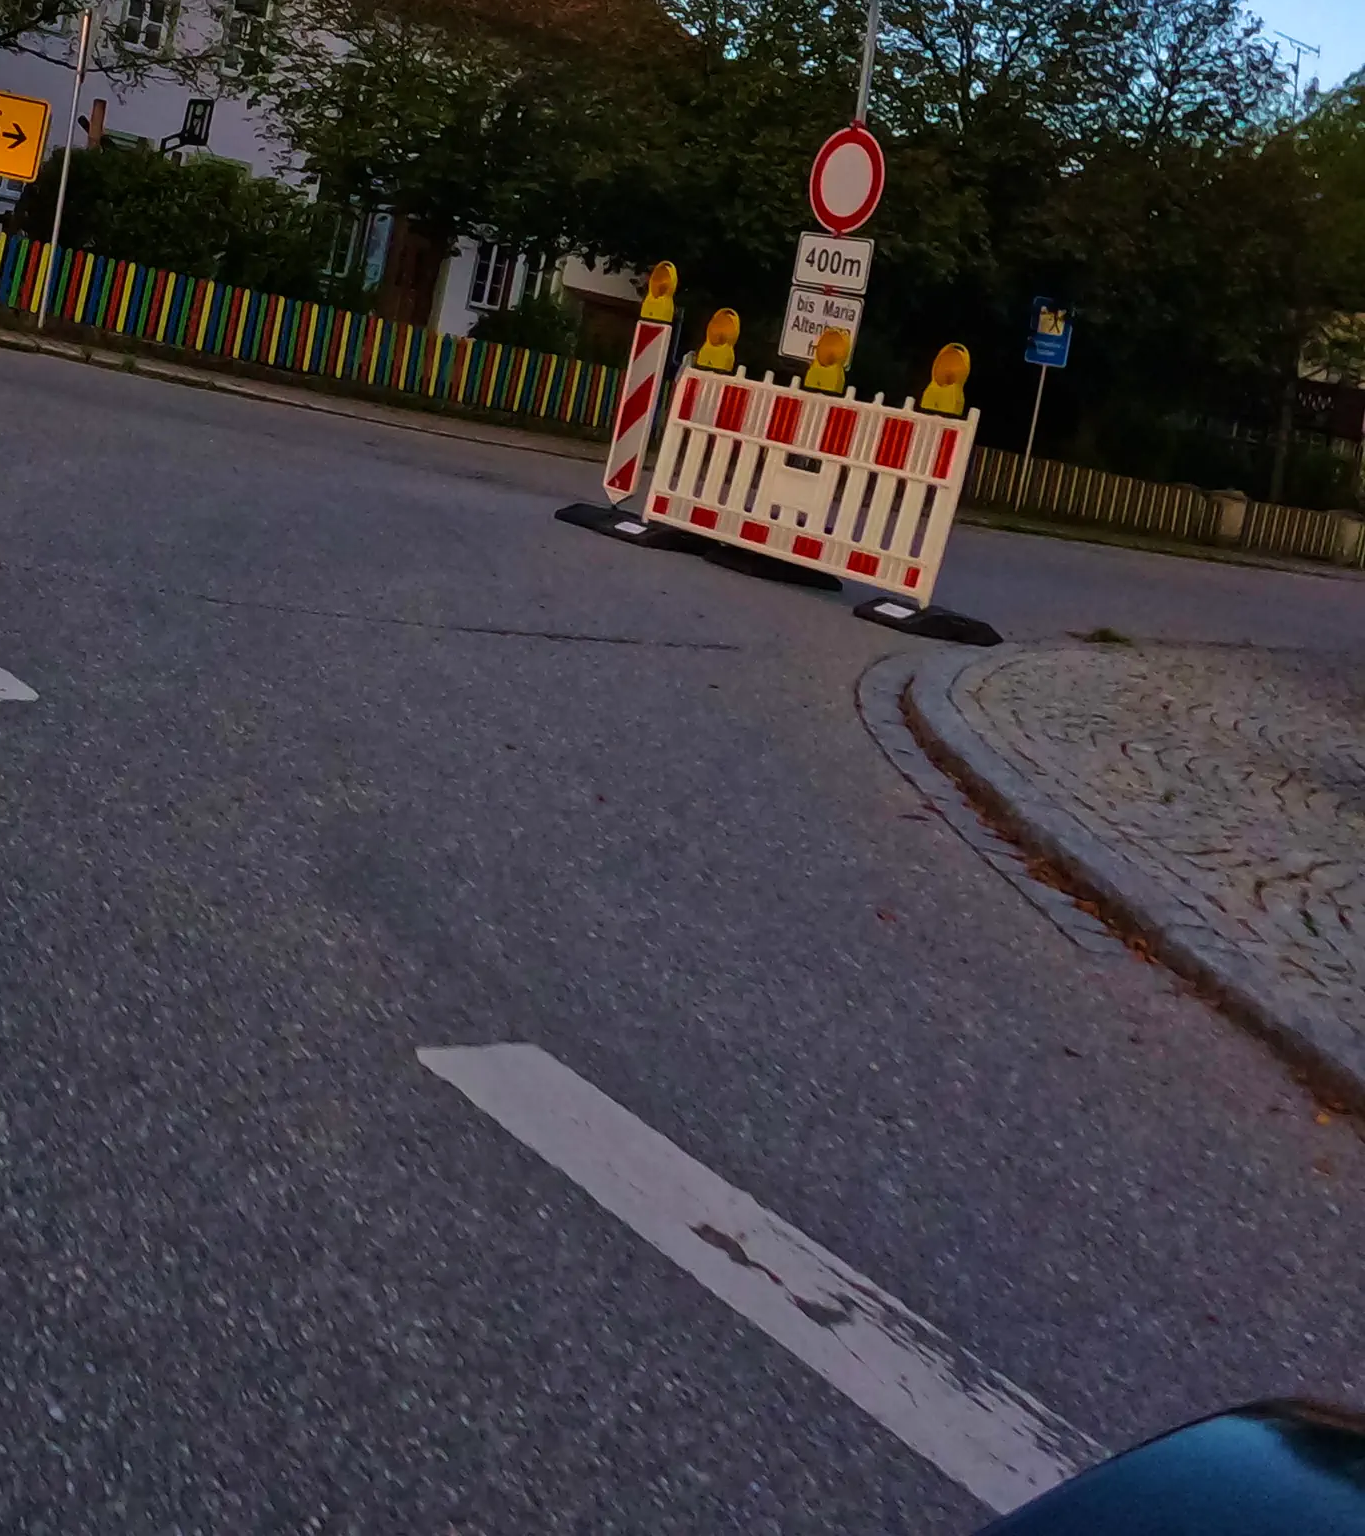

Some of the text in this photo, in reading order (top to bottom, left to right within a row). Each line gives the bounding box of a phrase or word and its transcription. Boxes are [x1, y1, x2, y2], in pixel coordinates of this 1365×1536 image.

[804, 247, 862, 278] 400m
[796, 294, 857, 323] bis Maria
[791, 315, 852, 338] Alten
